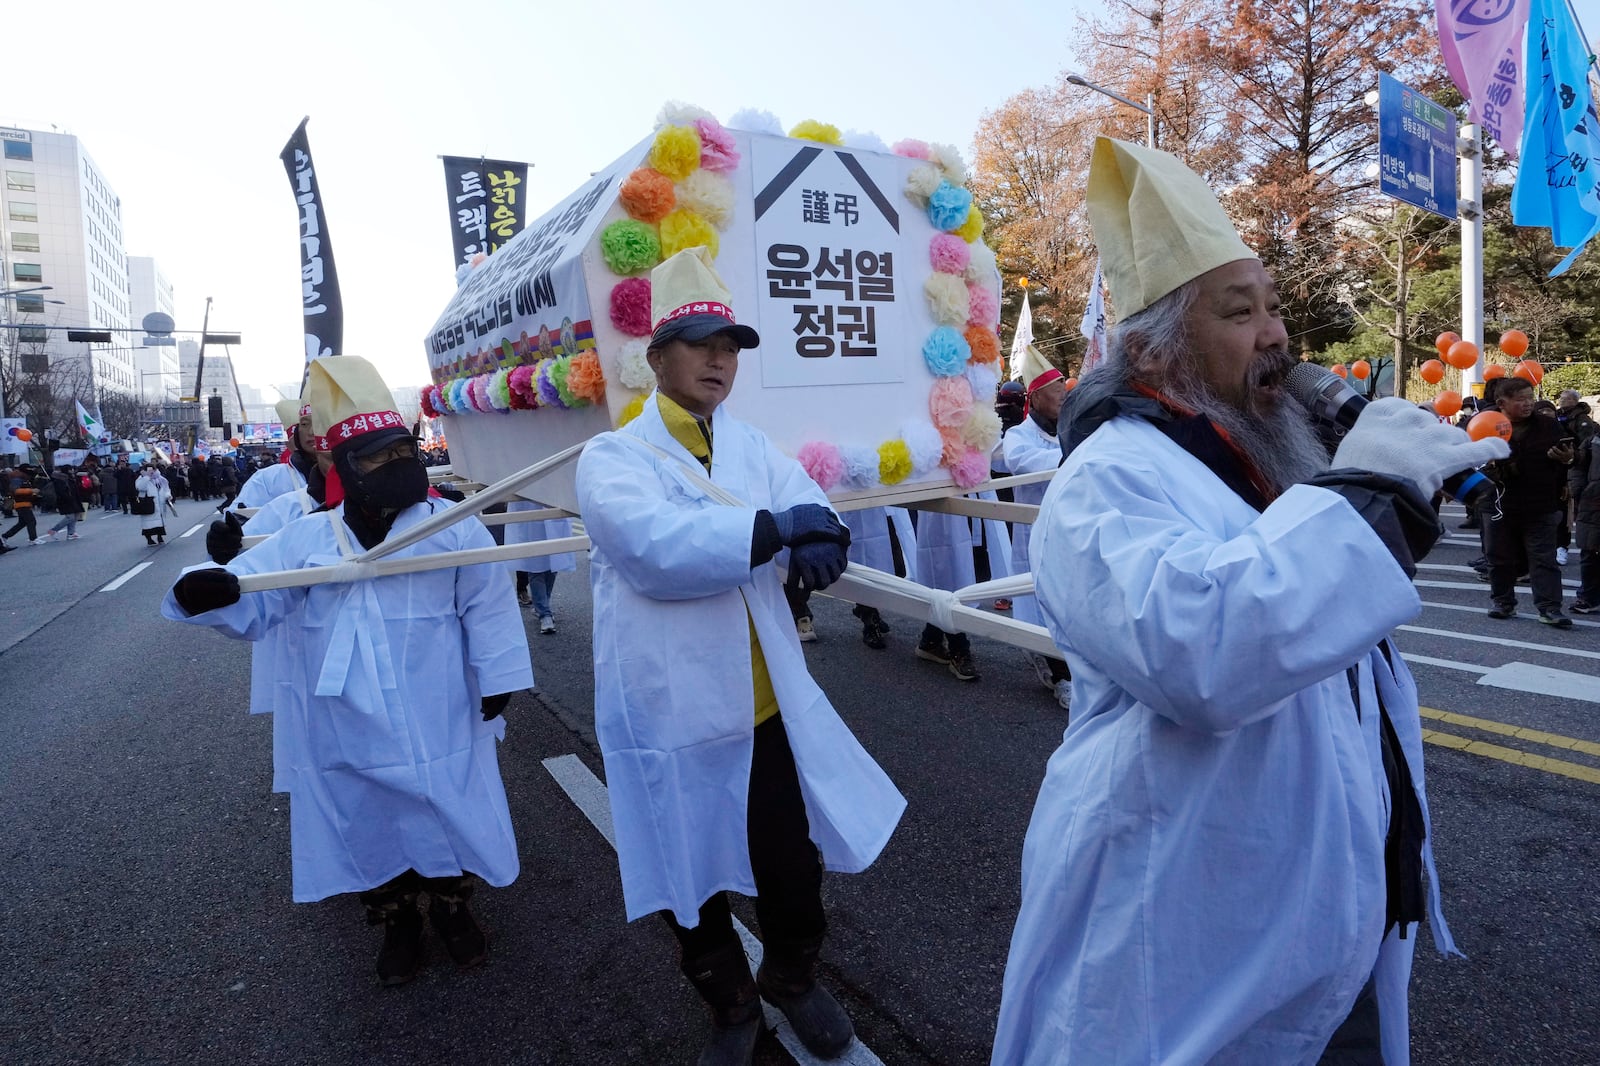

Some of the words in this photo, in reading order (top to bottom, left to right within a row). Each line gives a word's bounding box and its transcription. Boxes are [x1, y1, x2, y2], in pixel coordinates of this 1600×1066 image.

[1402, 116, 1430, 143] 영등포경찰서
[1382, 153, 1405, 179] 대방역
[487, 170, 521, 236] 낡은
[801, 188, 860, 227] 謹弔
[766, 243, 896, 302] 윤석열
[792, 304, 878, 358] 정권
